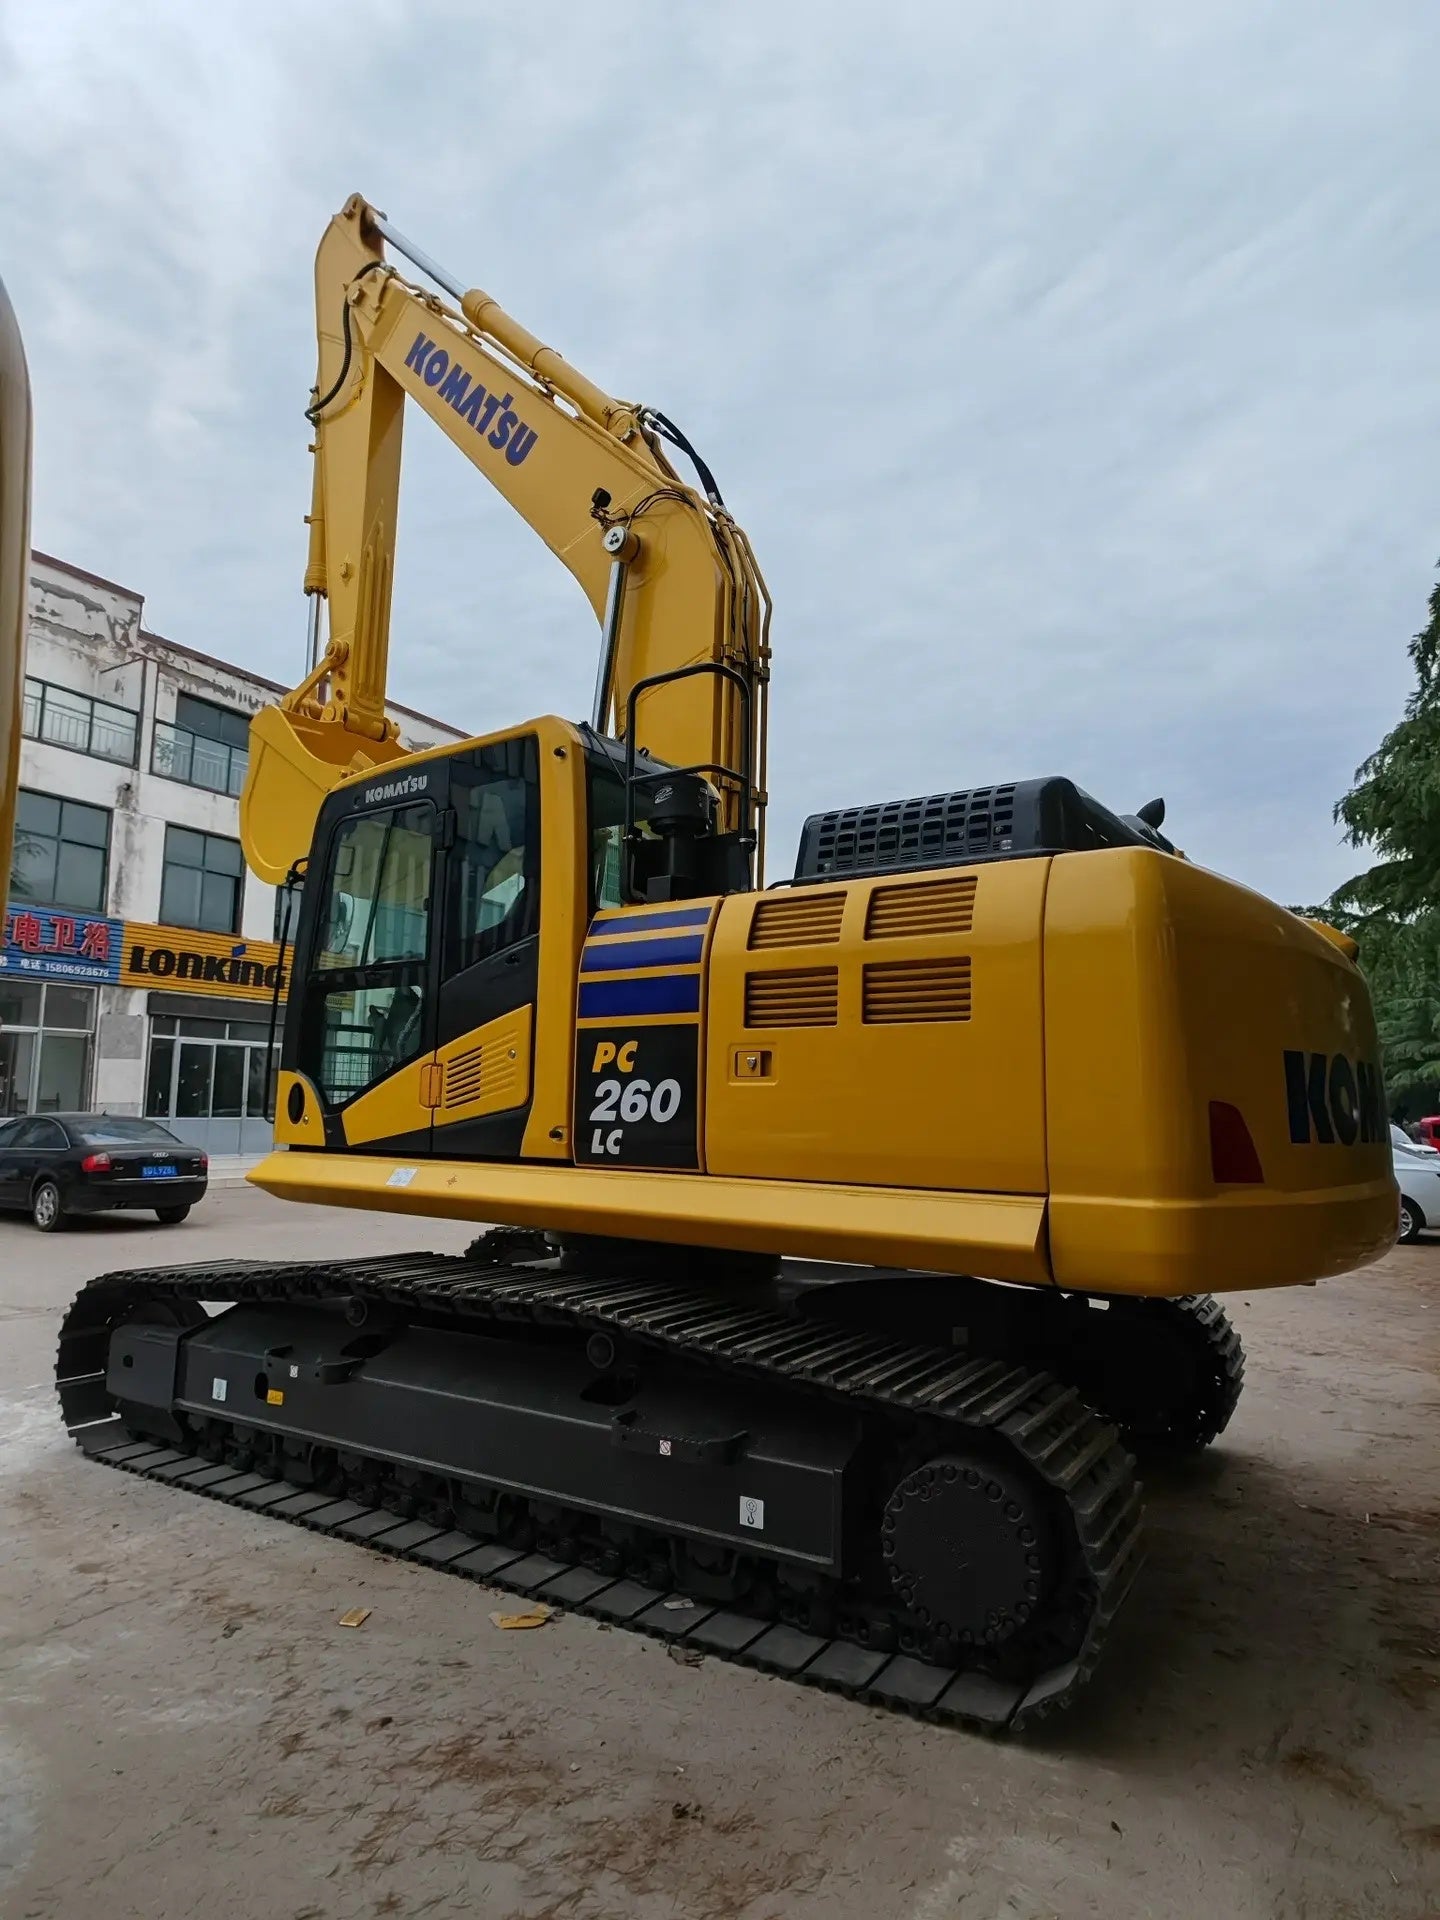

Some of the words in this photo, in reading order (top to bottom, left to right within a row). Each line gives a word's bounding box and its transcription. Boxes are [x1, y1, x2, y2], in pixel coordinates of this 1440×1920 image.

[404, 331, 539, 467] KOMATSU
[365, 774, 428, 803] KOMATSU
[3, 911, 110, 961] 电卫浴
[592, 1040, 638, 1073] PC
[589, 1079, 681, 1123] 260
[591, 1128, 623, 1155] LC
